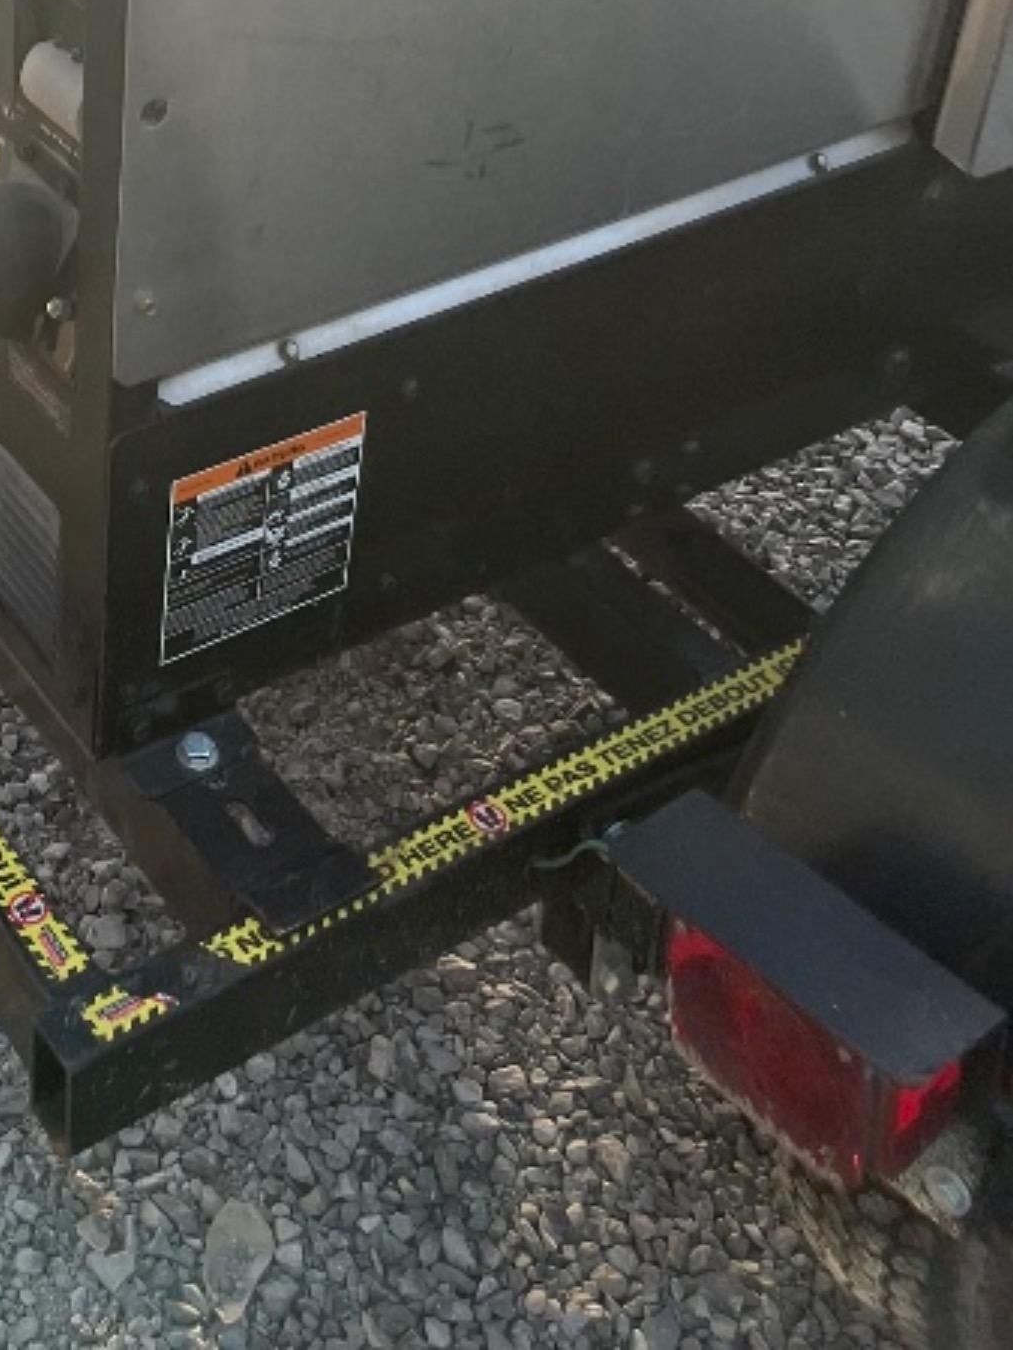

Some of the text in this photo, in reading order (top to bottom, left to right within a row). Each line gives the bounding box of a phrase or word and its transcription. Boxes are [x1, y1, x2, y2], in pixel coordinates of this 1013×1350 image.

[503, 785, 547, 813] NE
[541, 760, 597, 793] PAS
[598, 719, 681, 765] TENEZ
[675, 668, 776, 726] DEBOUT
[398, 820, 476, 867] HERE
